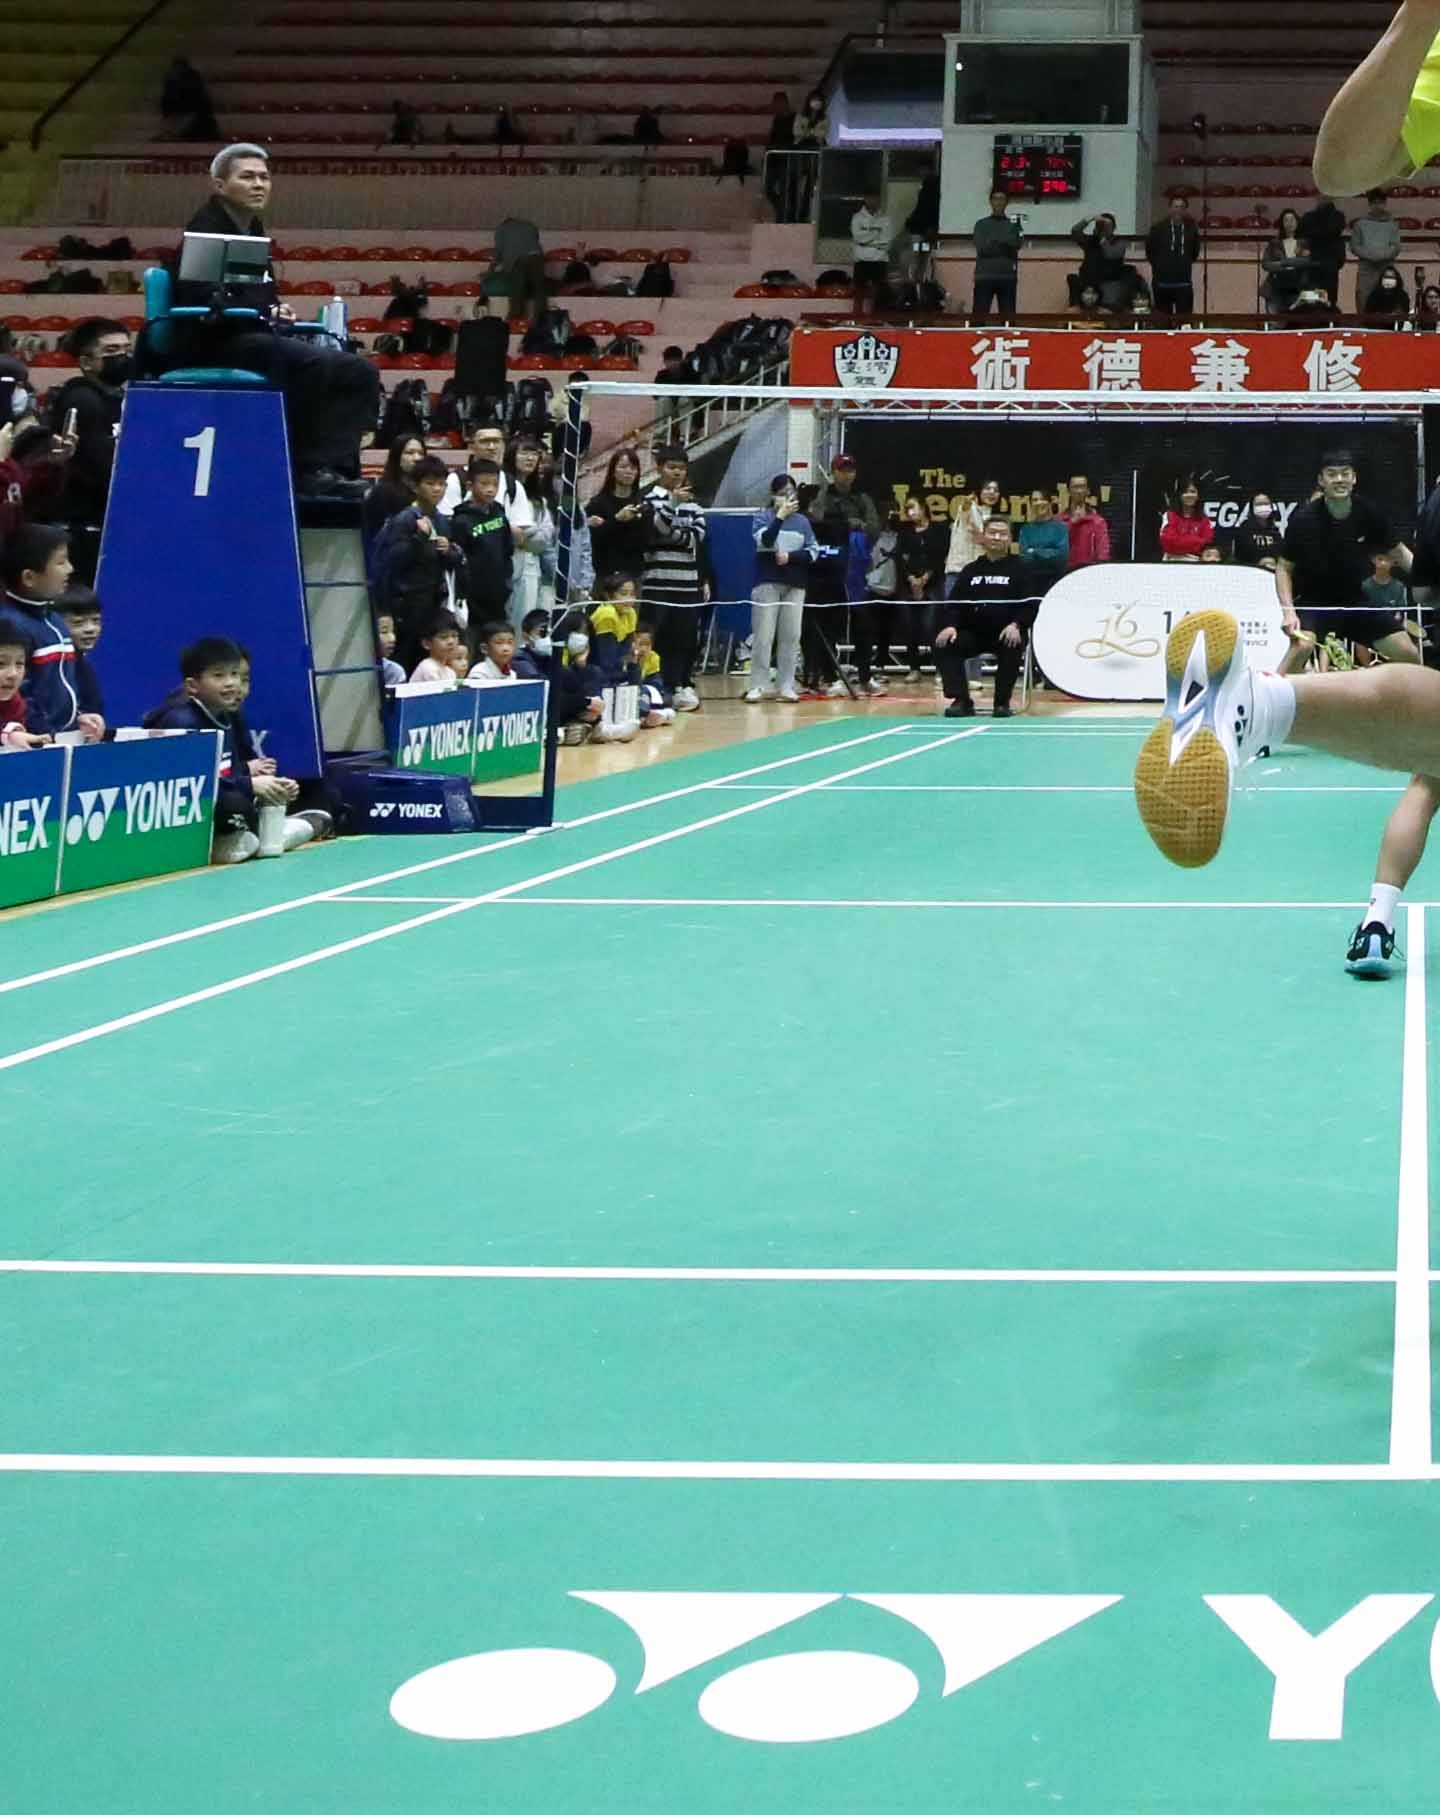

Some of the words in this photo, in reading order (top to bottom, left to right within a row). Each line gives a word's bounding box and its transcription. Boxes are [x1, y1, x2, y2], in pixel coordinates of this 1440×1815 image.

[183, 426, 216, 497] 1
[919, 467, 966, 489] The
[429, 718, 472, 761] YONEX
[501, 710, 540, 746] YONEX
[124, 775, 207, 834] YONEX
[398, 802, 443, 819] YONEX
